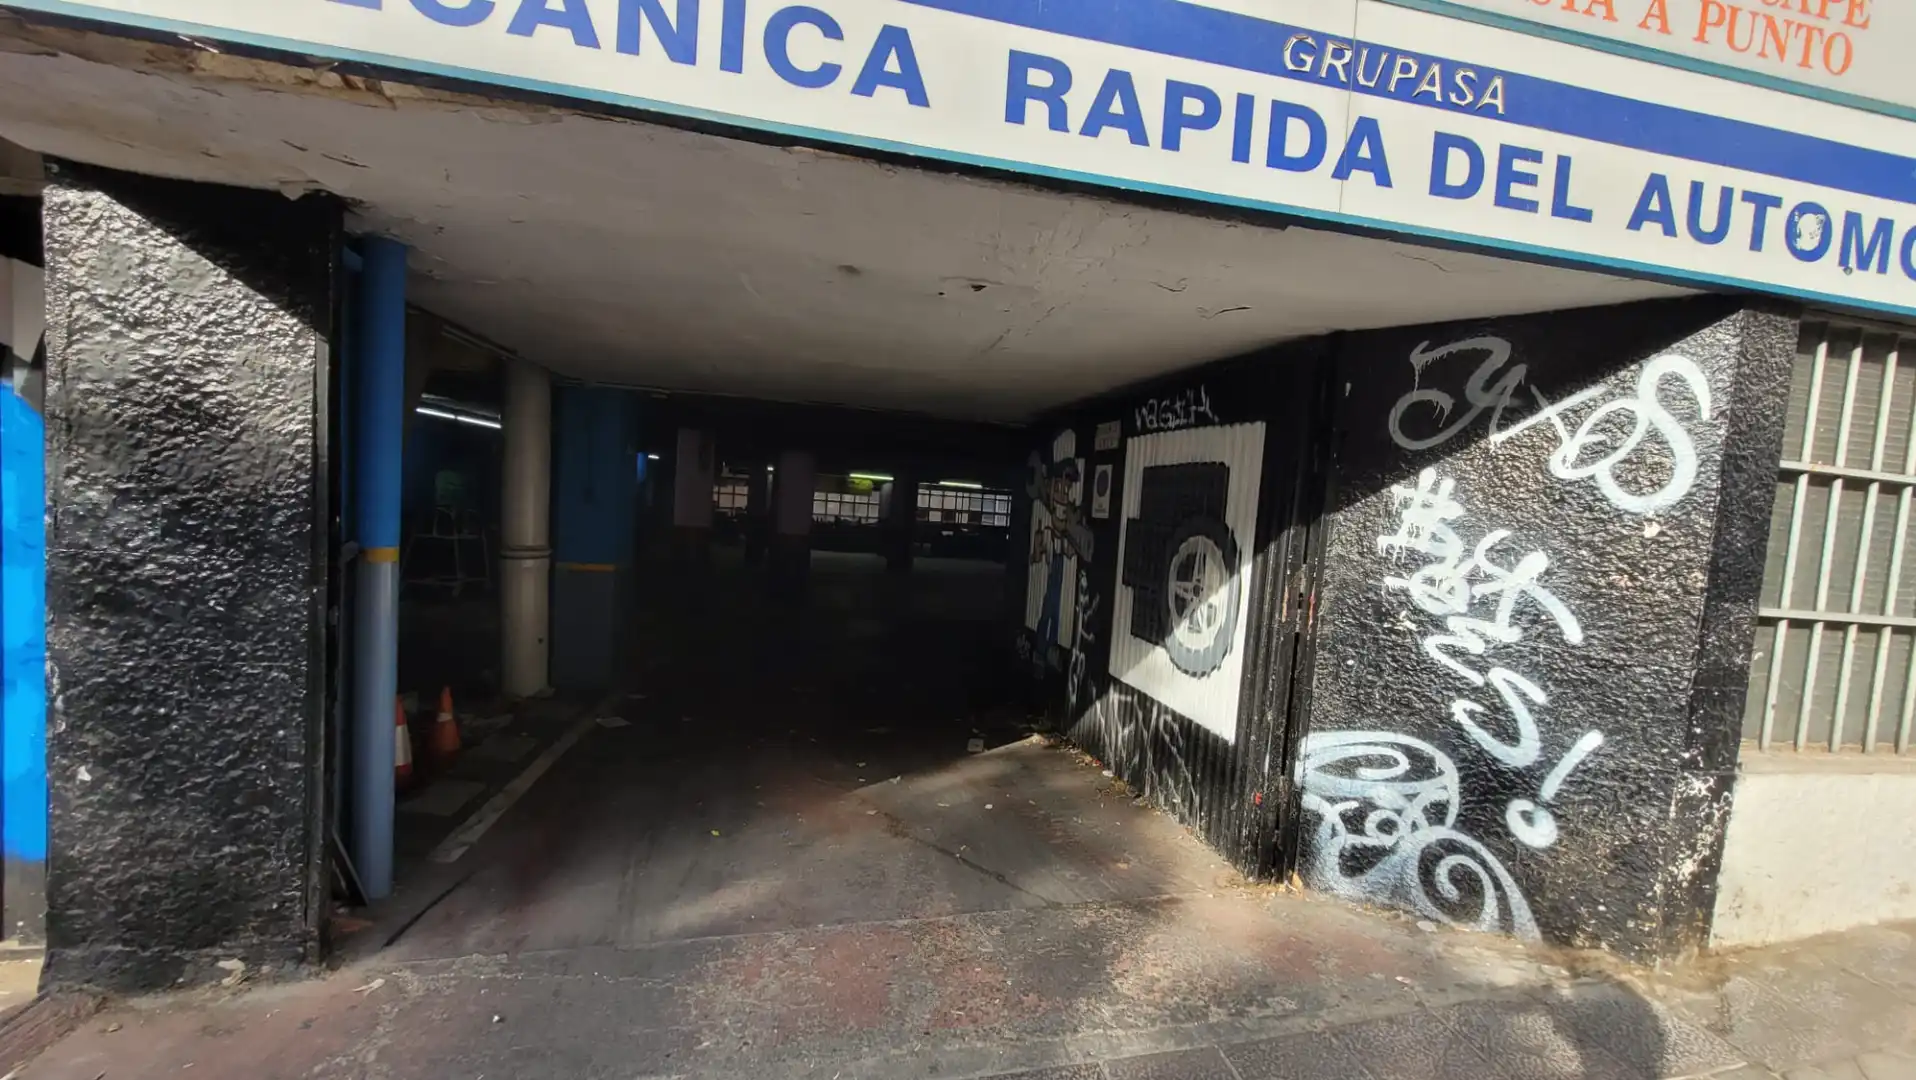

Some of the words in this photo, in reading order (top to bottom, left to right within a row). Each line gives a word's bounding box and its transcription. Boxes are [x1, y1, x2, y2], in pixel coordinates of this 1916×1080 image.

[1283, 34, 1506, 115] GRUPASA
[1693, 1, 1853, 76] PUNTO
[1005, 49, 1393, 188] RAPIDA
[1428, 131, 1593, 223] DEL
